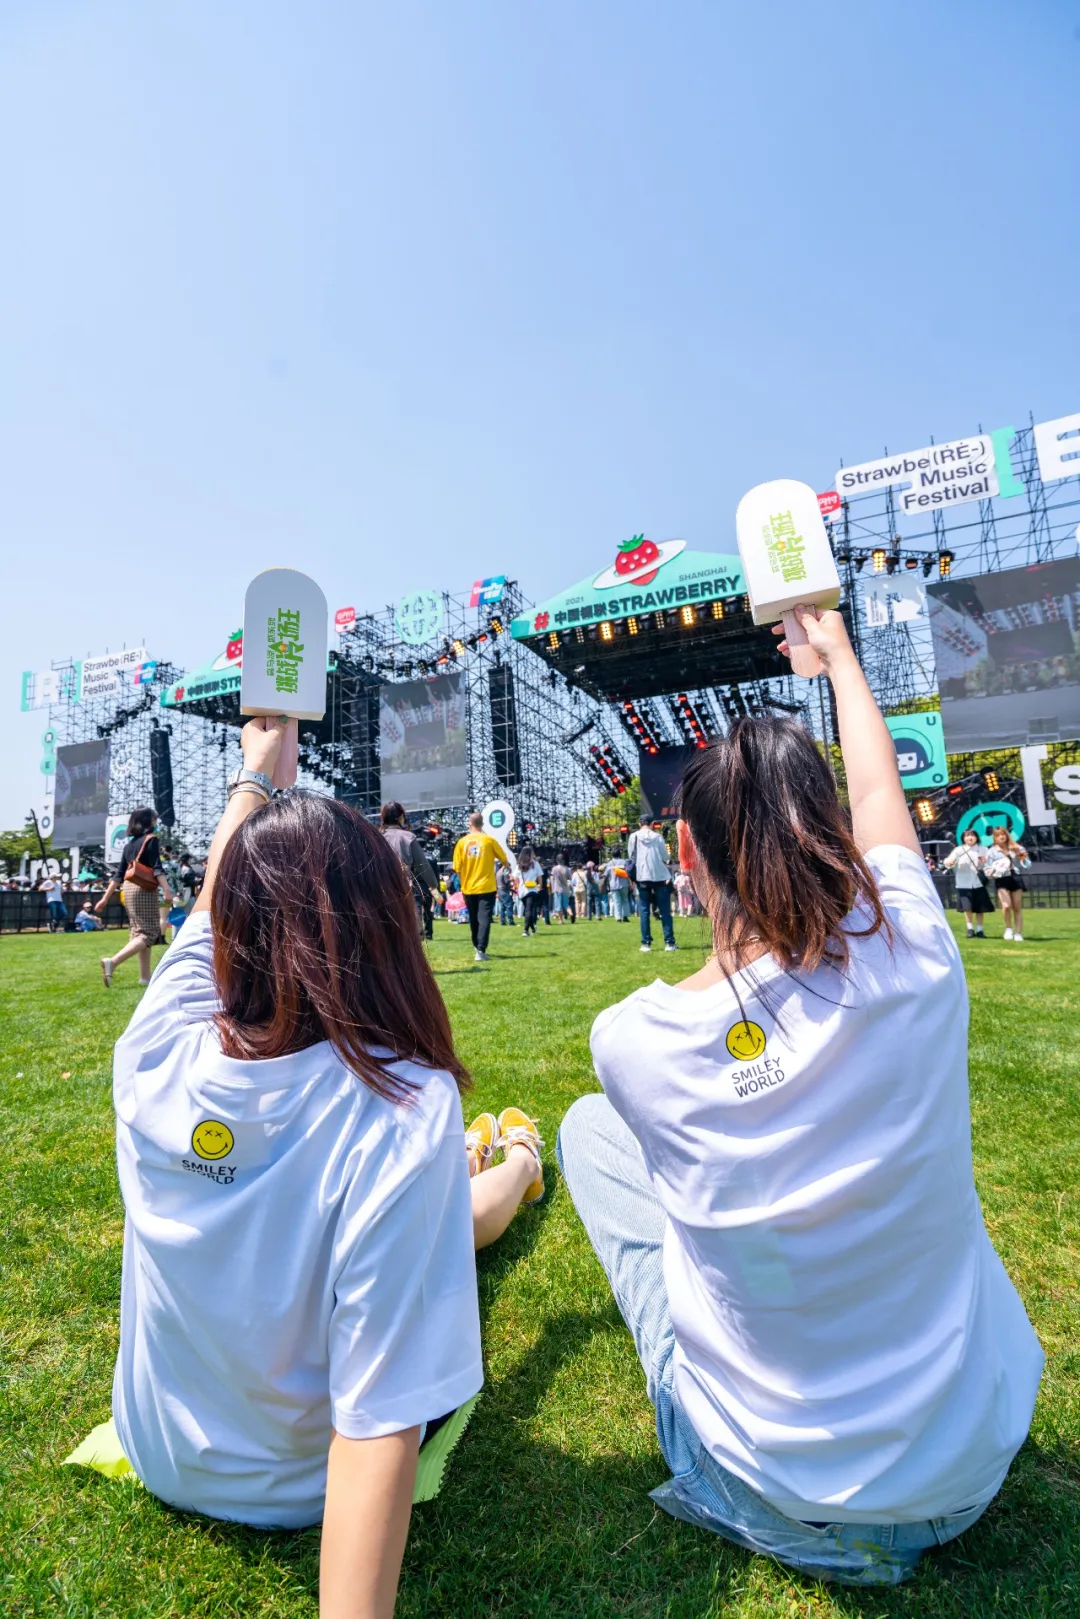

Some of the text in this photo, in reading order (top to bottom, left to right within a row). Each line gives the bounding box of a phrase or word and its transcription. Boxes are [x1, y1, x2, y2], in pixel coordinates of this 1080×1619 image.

[920, 461, 987, 487] Music
[904, 477, 989, 509] Festival
[679, 566, 727, 582] SHANGHAI
[565, 596, 584, 606] 2021
[608, 575, 740, 614] STRAWBERRY
[84, 671, 109, 684] Music
[83, 680, 117, 696] Festival
[491, 811, 503, 826] E
[731, 1056, 781, 1085] SMILEY
[734, 1069, 785, 1098] WORLD
[182, 1159, 237, 1176] SMILEY
